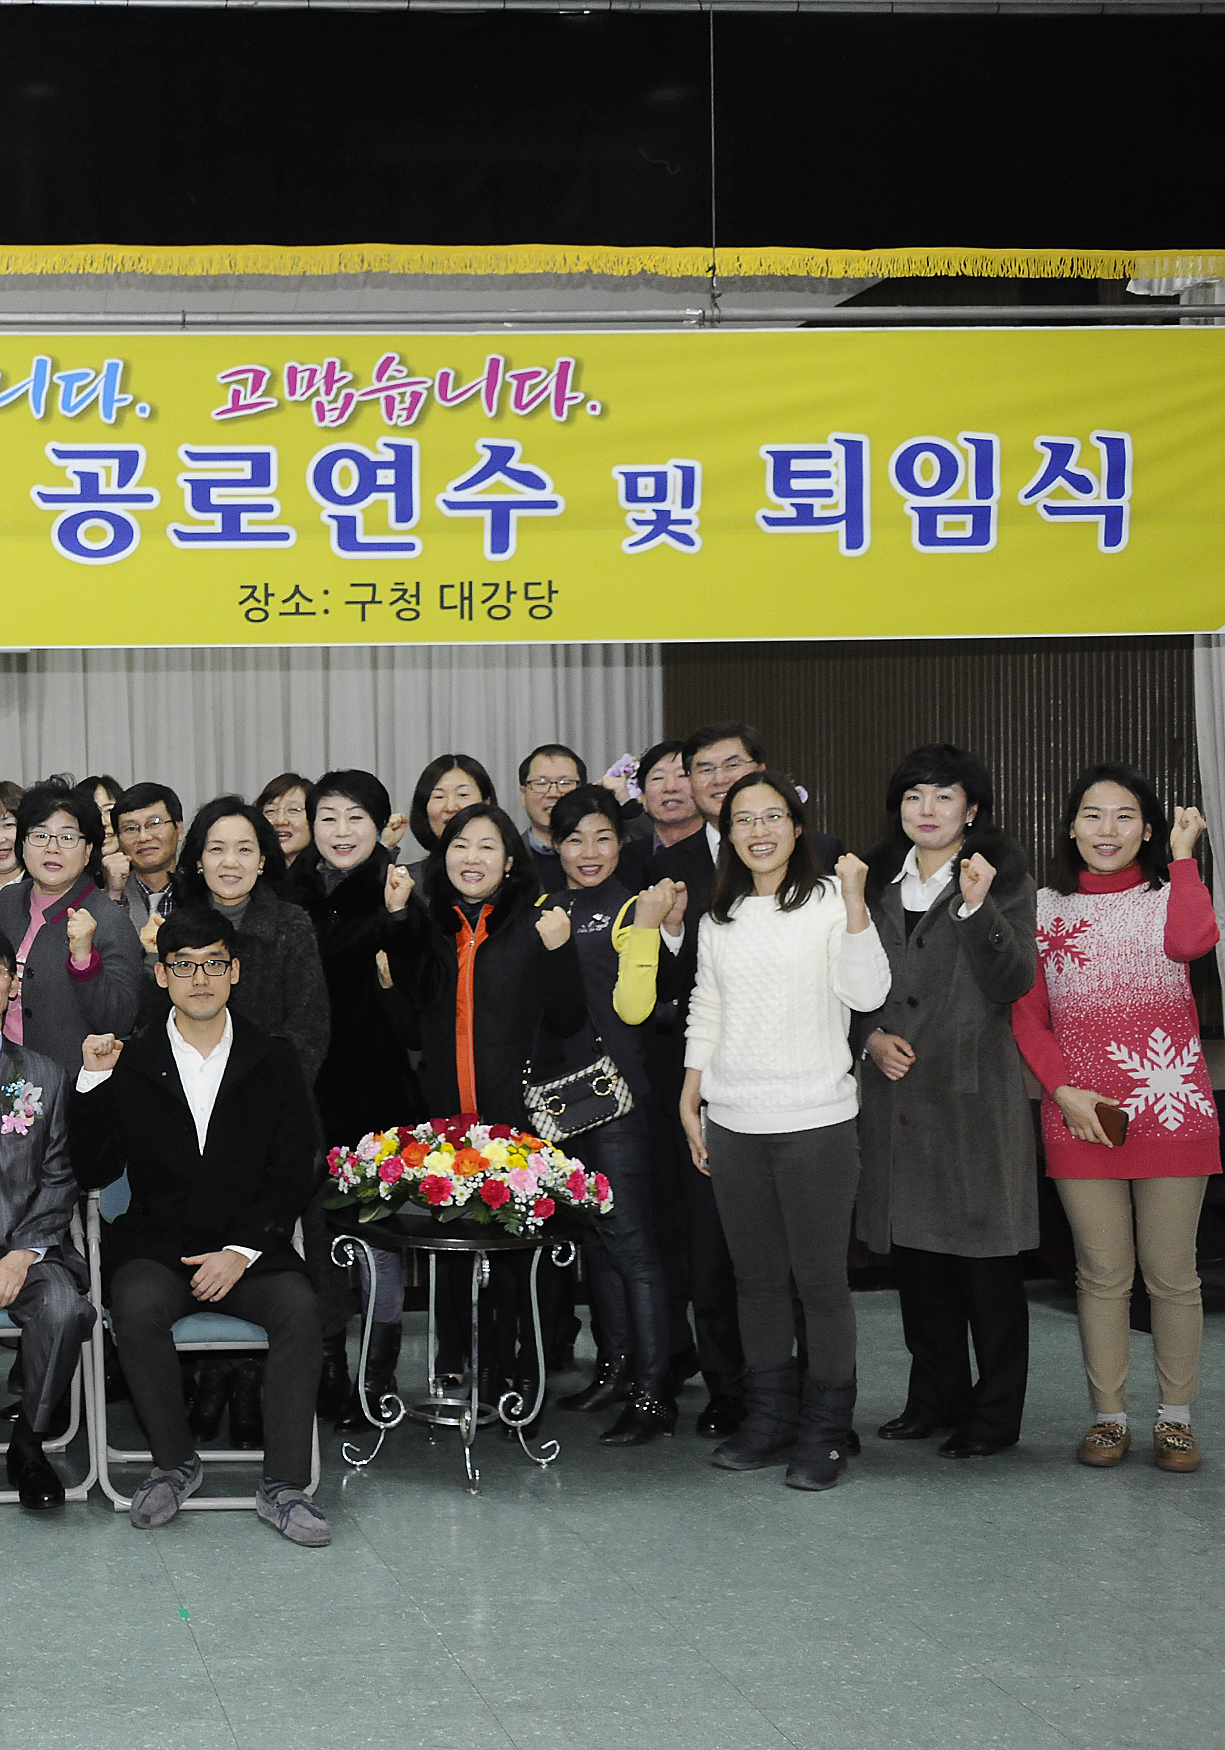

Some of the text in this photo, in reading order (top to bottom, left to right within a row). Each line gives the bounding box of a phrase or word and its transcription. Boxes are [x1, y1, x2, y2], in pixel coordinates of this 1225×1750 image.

[214, 355, 598, 424] 고맙습니다.
[33, 439, 562, 562] 공로연수
[615, 461, 699, 551] 및
[758, 432, 1130, 554] 퇴임식
[237, 578, 560, 624] 장소: 구청 대강당
